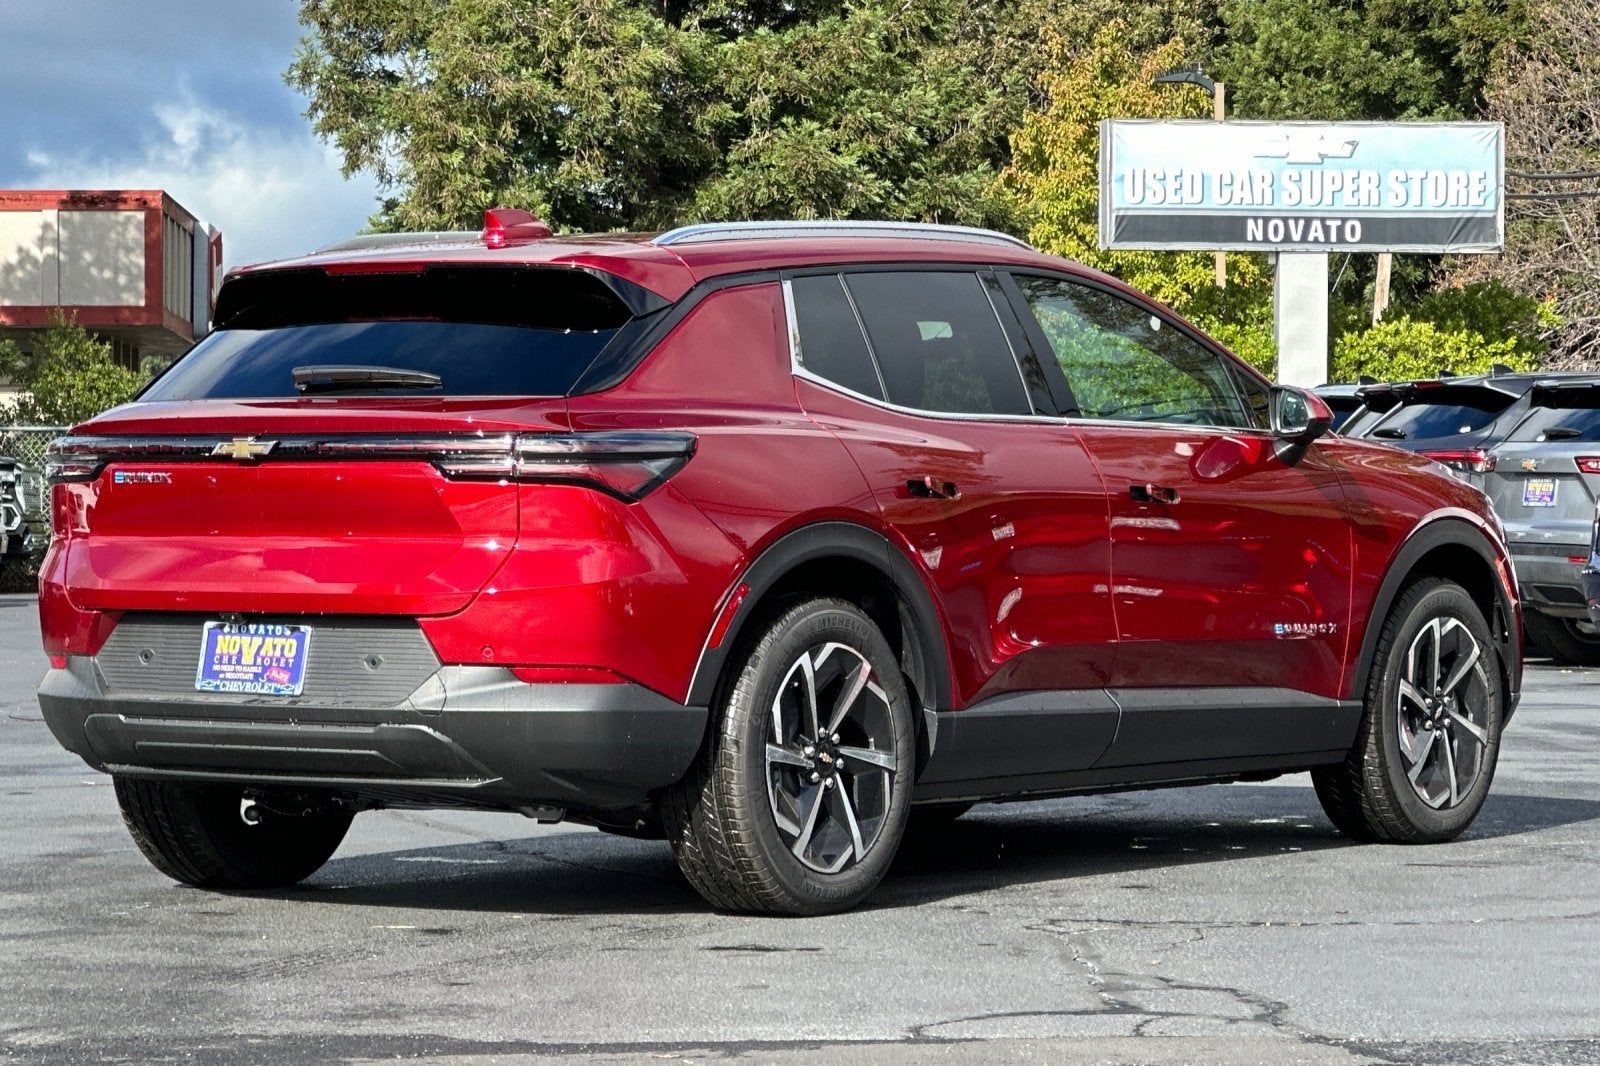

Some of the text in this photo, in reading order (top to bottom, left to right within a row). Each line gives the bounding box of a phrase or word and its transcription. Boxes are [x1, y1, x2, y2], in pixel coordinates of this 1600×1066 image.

[1123, 168, 1487, 207] USED CAR SUPER STORE
[1246, 218, 1362, 243] NOVATO
[114, 471, 173, 484] EQUINOX
[1274, 622, 1337, 634] EQUINOX
[215, 635, 298, 665] NOVATO
[219, 681, 276, 693] CHEVROLET
